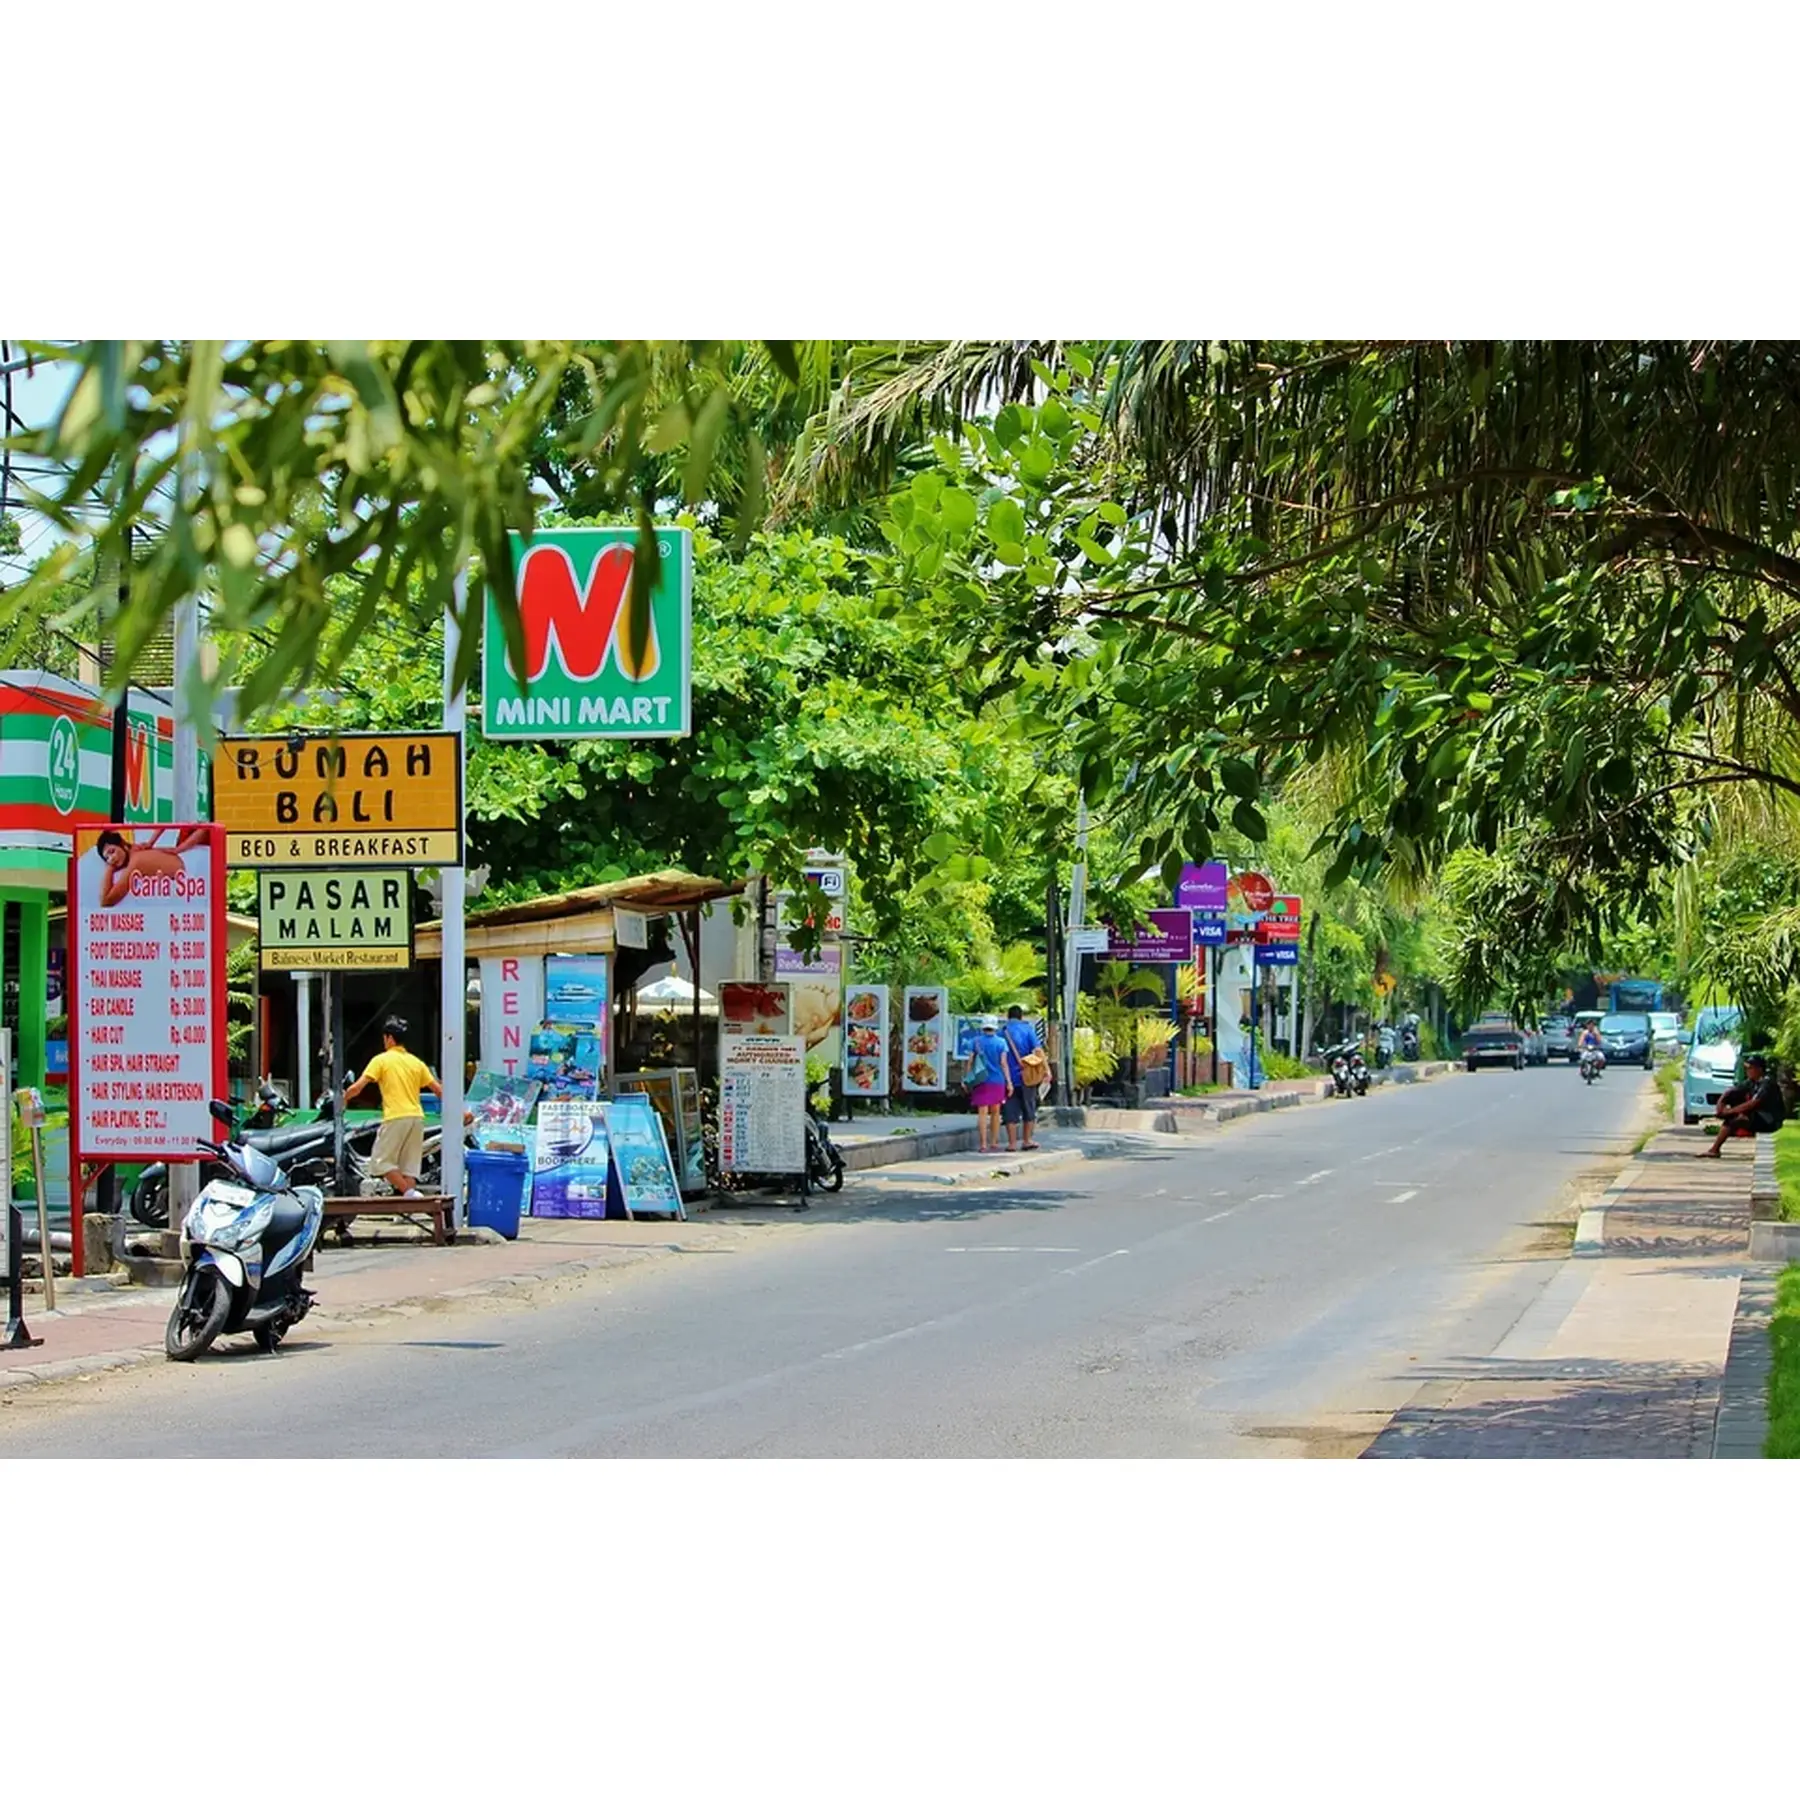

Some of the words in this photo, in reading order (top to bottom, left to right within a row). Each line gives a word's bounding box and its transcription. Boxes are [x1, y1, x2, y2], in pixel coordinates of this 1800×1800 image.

[496, 697, 570, 724] MINI
[578, 696, 671, 724] MART
[54, 729, 76, 779] 24
[237, 744, 431, 779] RUMAH
[276, 789, 394, 823] BALI
[241, 839, 276, 857] BED
[290, 840, 300, 856] &
[315, 837, 429, 857] BREAKFAST
[175, 870, 205, 902] Spa
[269, 879, 400, 910] PASAR
[90, 913, 109, 931] BODY
[111, 913, 144, 931] MASSAGE
[279, 917, 391, 939] MALAM
[1199, 925, 1222, 937] VISA
[90, 941, 109, 959] FOOT
[110, 941, 161, 960] REFLEXOLOGY
[271, 952, 311, 965] Balinese
[312, 951, 345, 965] Market
[346, 951, 398, 964] Restaurant
[1275, 950, 1296, 960] VISA
[91, 969, 107, 988] THAI
[109, 969, 142, 988] MASSAGE
[91, 997, 105, 1016] EAR
[106, 997, 134, 1016] CANDLE
[502, 959, 520, 1076] RENT
[91, 1026, 108, 1044] HAIR
[109, 1026, 124, 1044] CUT
[91, 1054, 108, 1072] HAIR
[127, 1054, 143, 1072] HAIR
[145, 1054, 180, 1072] STRAIGHT
[91, 1082, 108, 1100] HAIR
[146, 1083, 162, 1100] HAIR
[164, 1083, 204, 1100] EXTENSION
[91, 1110, 108, 1128] HAIR
